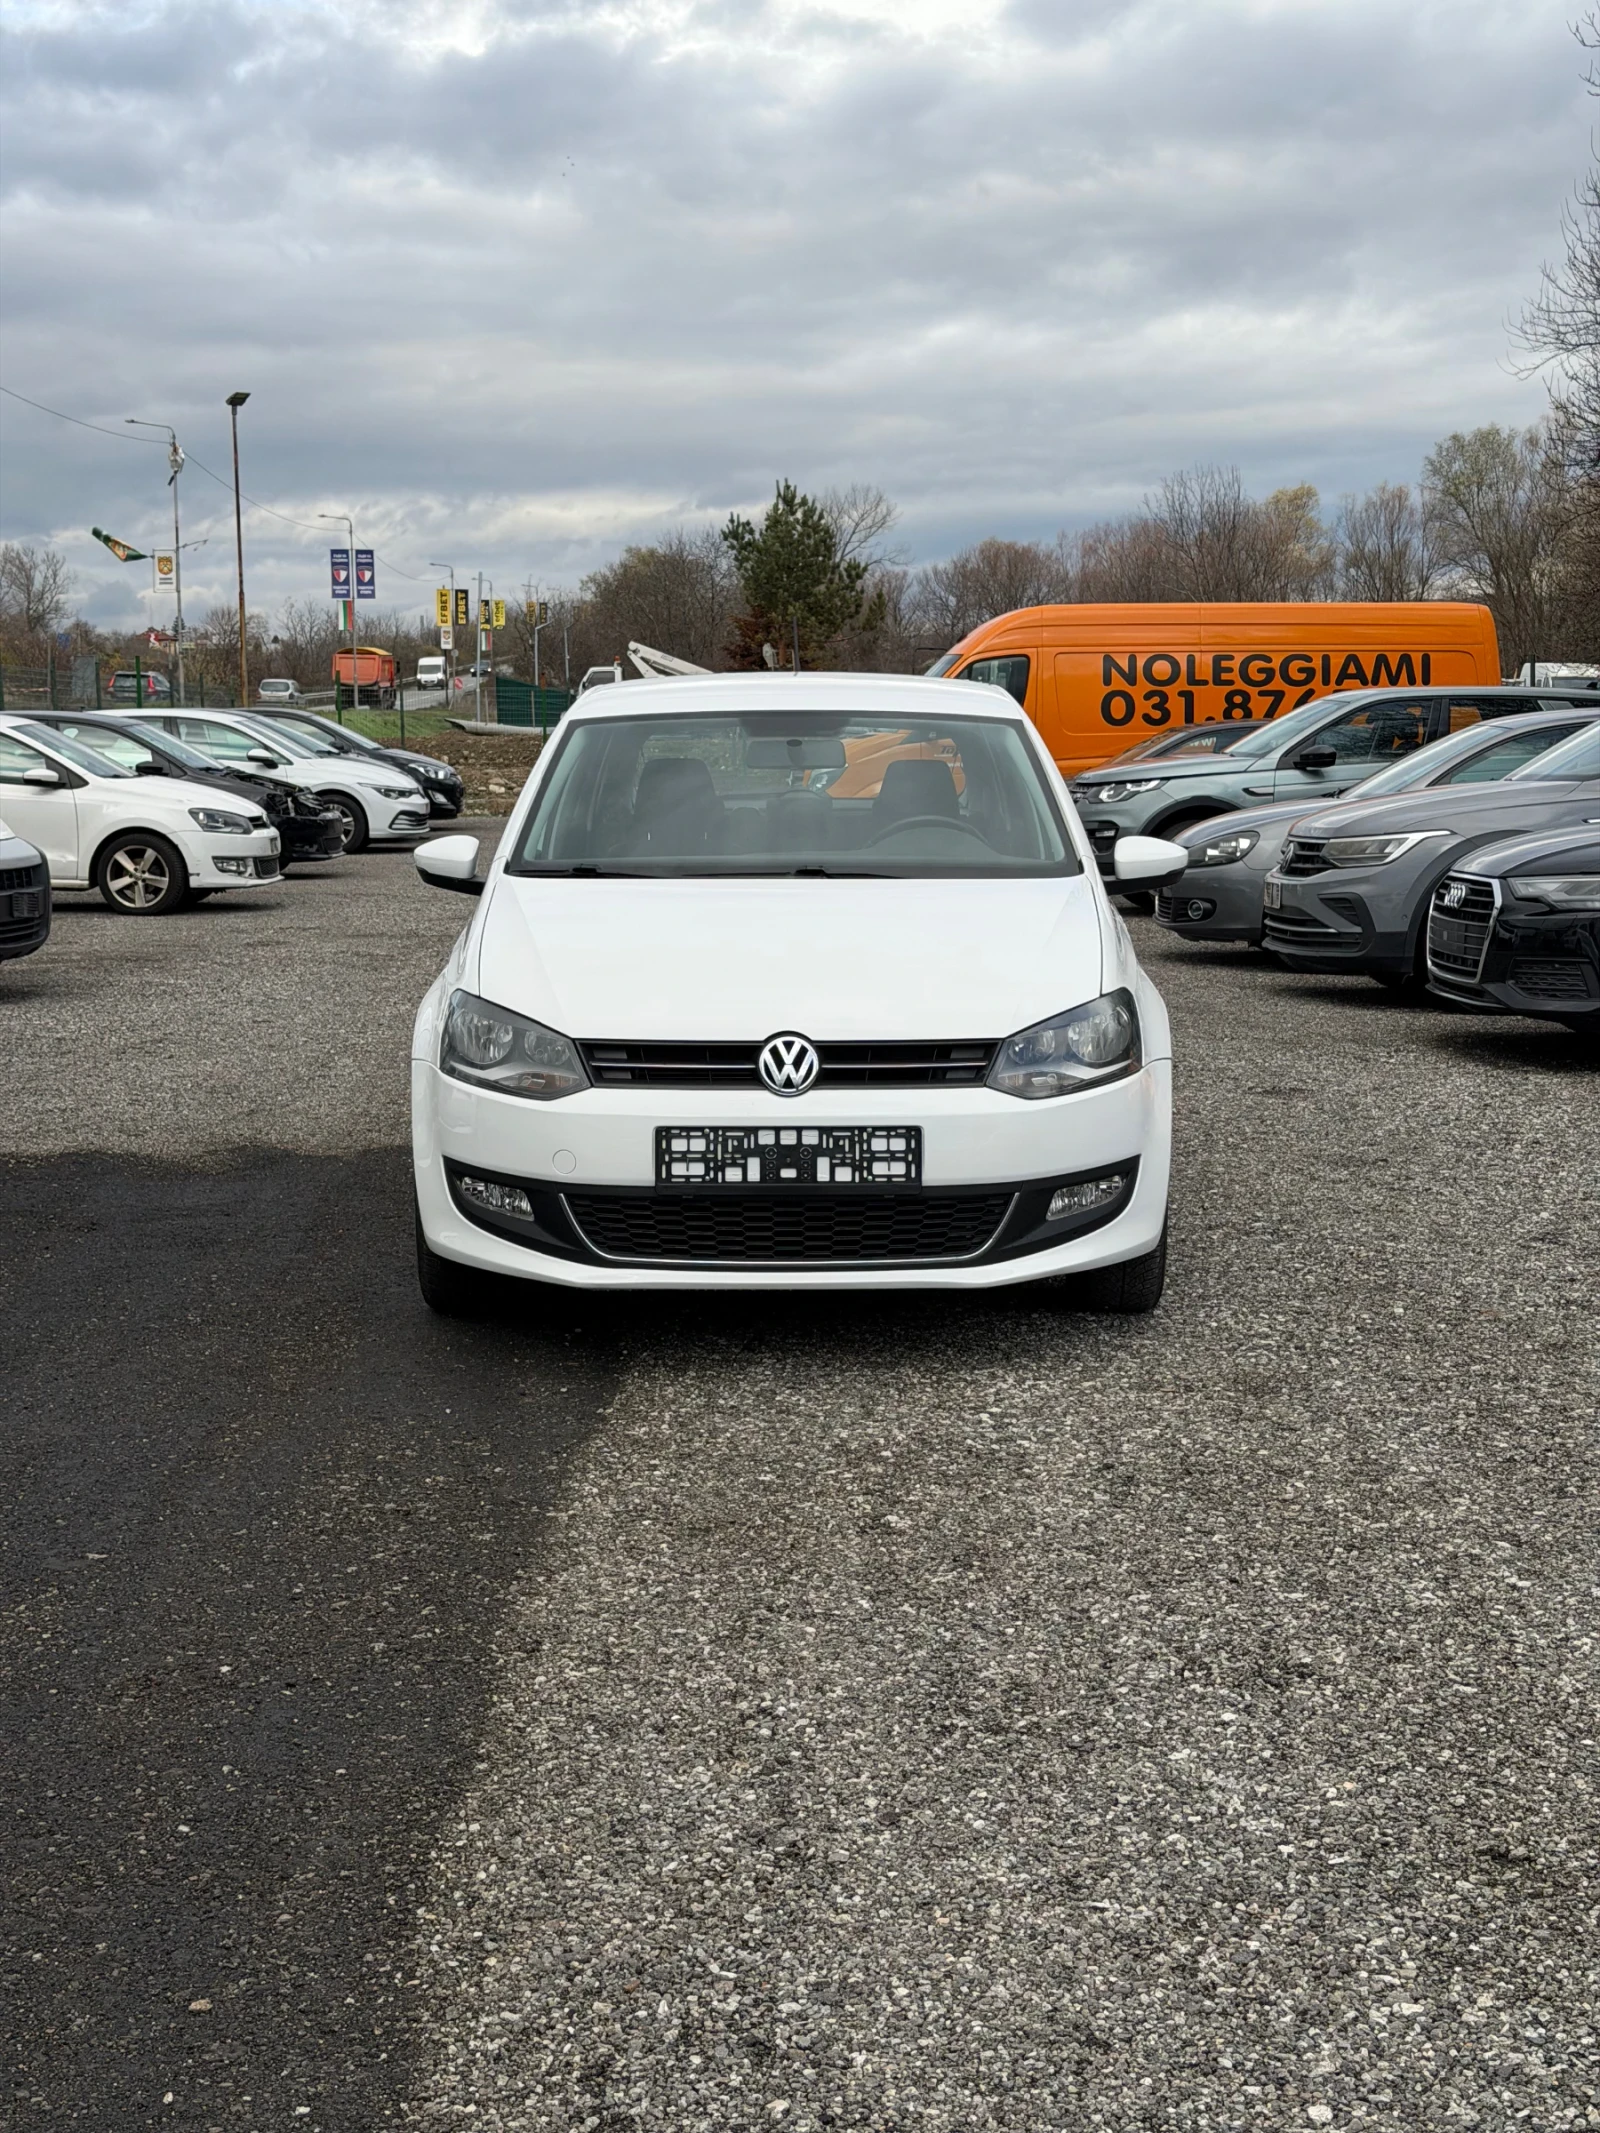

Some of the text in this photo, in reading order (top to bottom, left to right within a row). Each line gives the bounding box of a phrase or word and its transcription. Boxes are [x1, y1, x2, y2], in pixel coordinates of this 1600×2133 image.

[440, 591, 448, 624] EFBET
[457, 591, 466, 625] EFBET
[1102, 653, 1431, 687] NOLEGGIAMI
[1101, 689, 1352, 727] 031.87
[760, 1037, 817, 1090] VW
